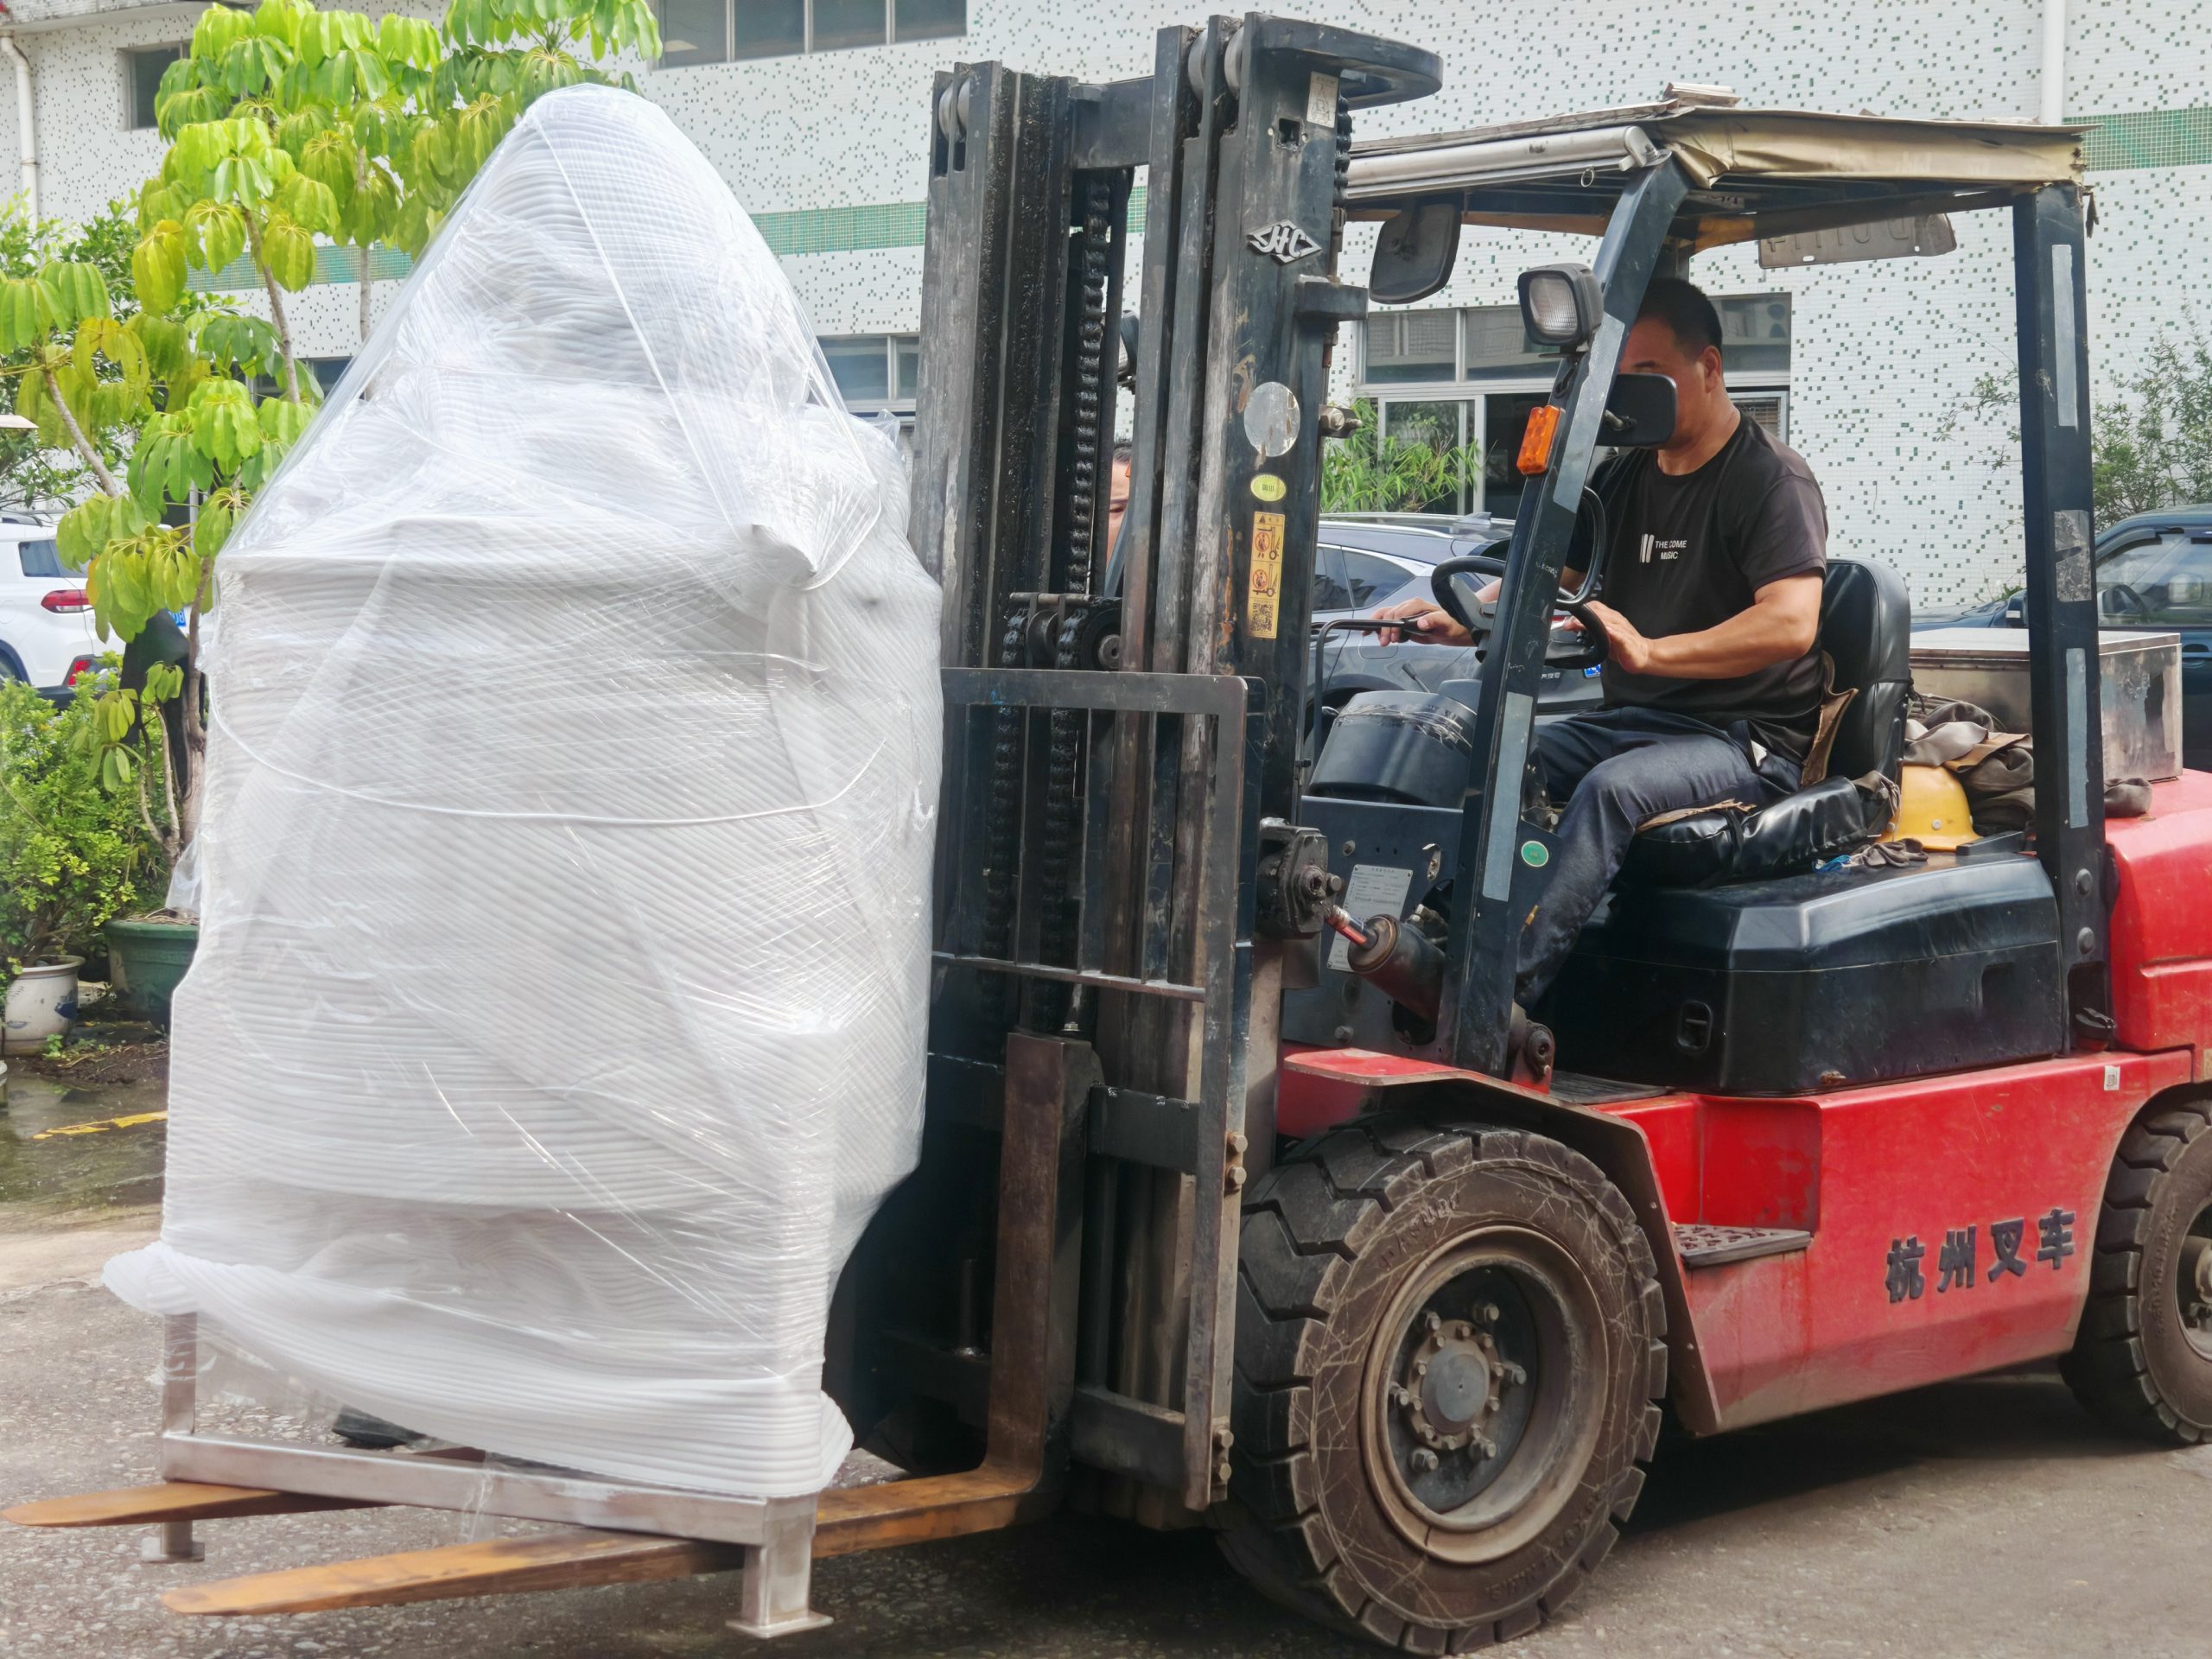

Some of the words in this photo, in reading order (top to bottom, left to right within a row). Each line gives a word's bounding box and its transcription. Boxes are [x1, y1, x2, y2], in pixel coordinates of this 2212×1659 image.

[1655, 540, 1669, 549] THE
[1660, 551, 1679, 560] MUSIC
[1885, 1207, 2075, 1303] 杭州叉车
